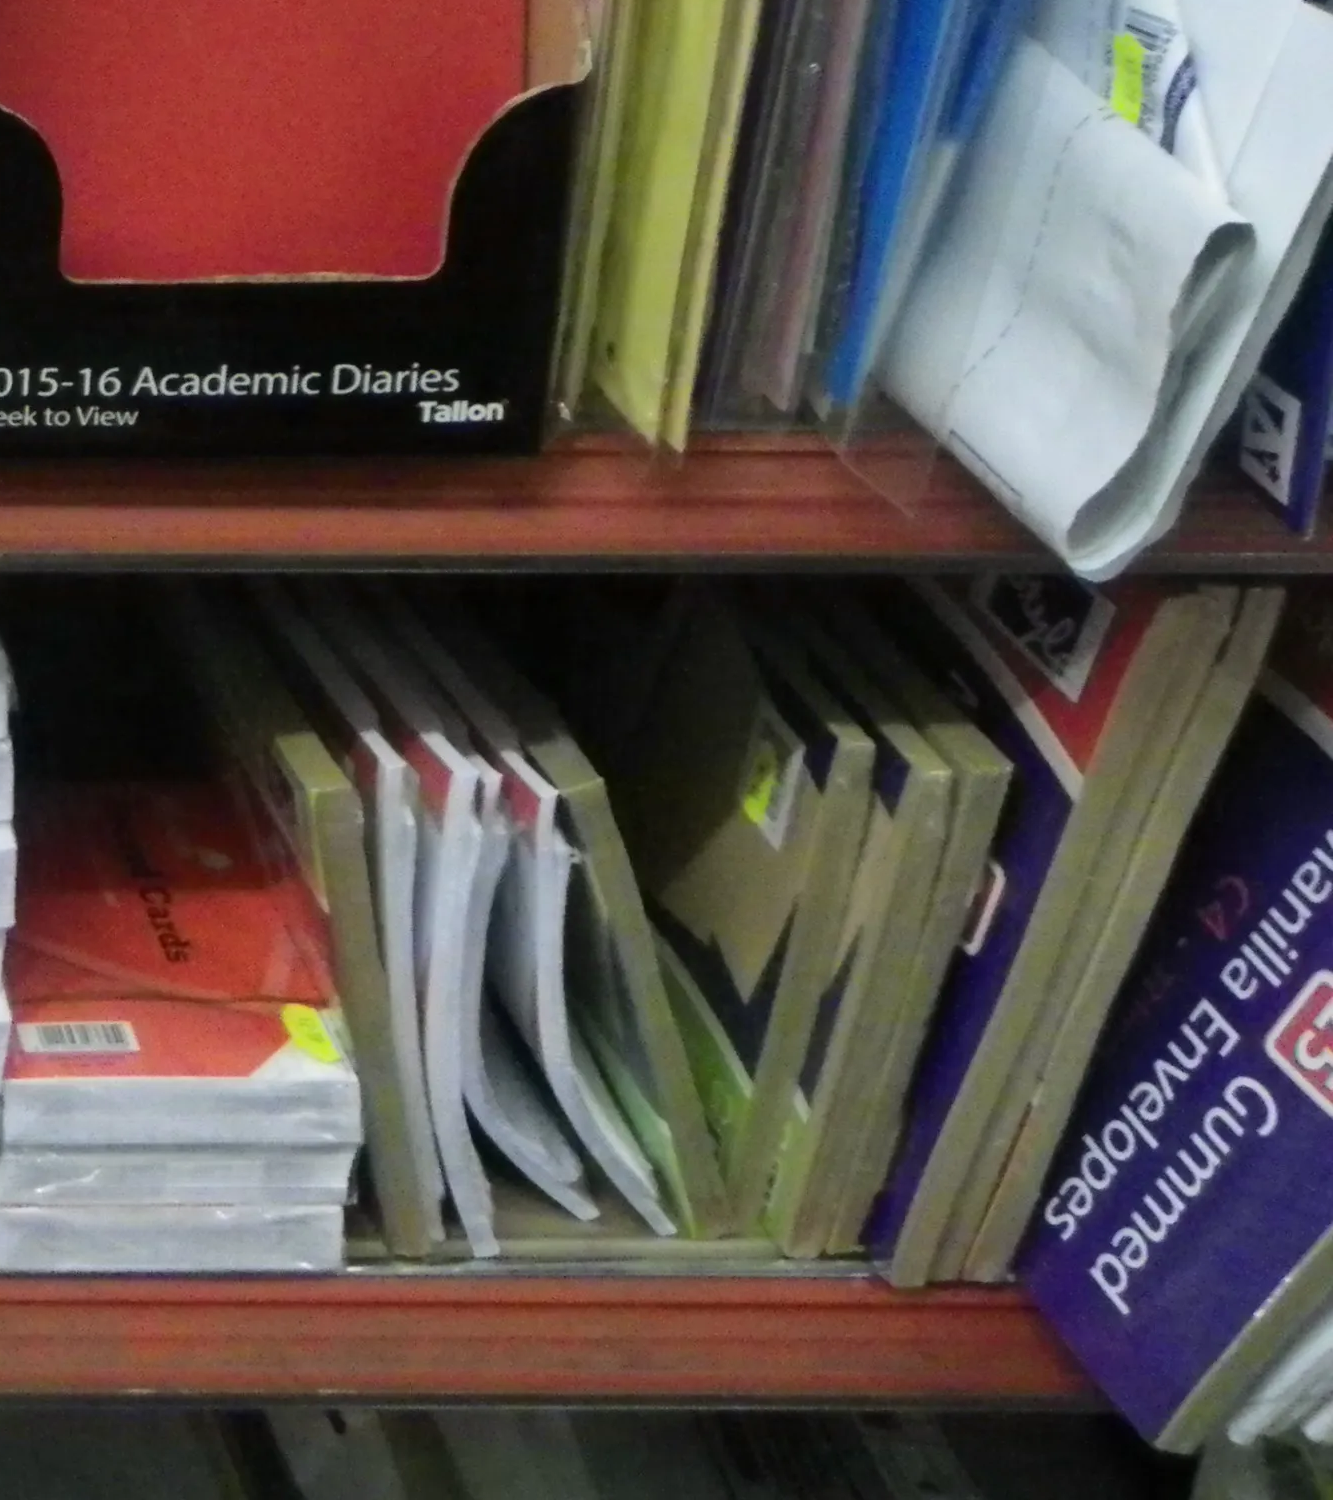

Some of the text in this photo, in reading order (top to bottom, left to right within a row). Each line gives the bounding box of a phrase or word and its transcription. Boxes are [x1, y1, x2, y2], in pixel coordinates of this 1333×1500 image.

[43, 408, 71, 427] to
[76, 405, 140, 428] View
[132, 364, 322, 397] Academic
[332, 361, 461, 395] Diaries
[417, 399, 505, 425] Tallon
[1219, 829, 1333, 1001] anilla
[1044, 997, 1241, 1242] Envelopes
[1088, 1075, 1279, 1315] Gummed
